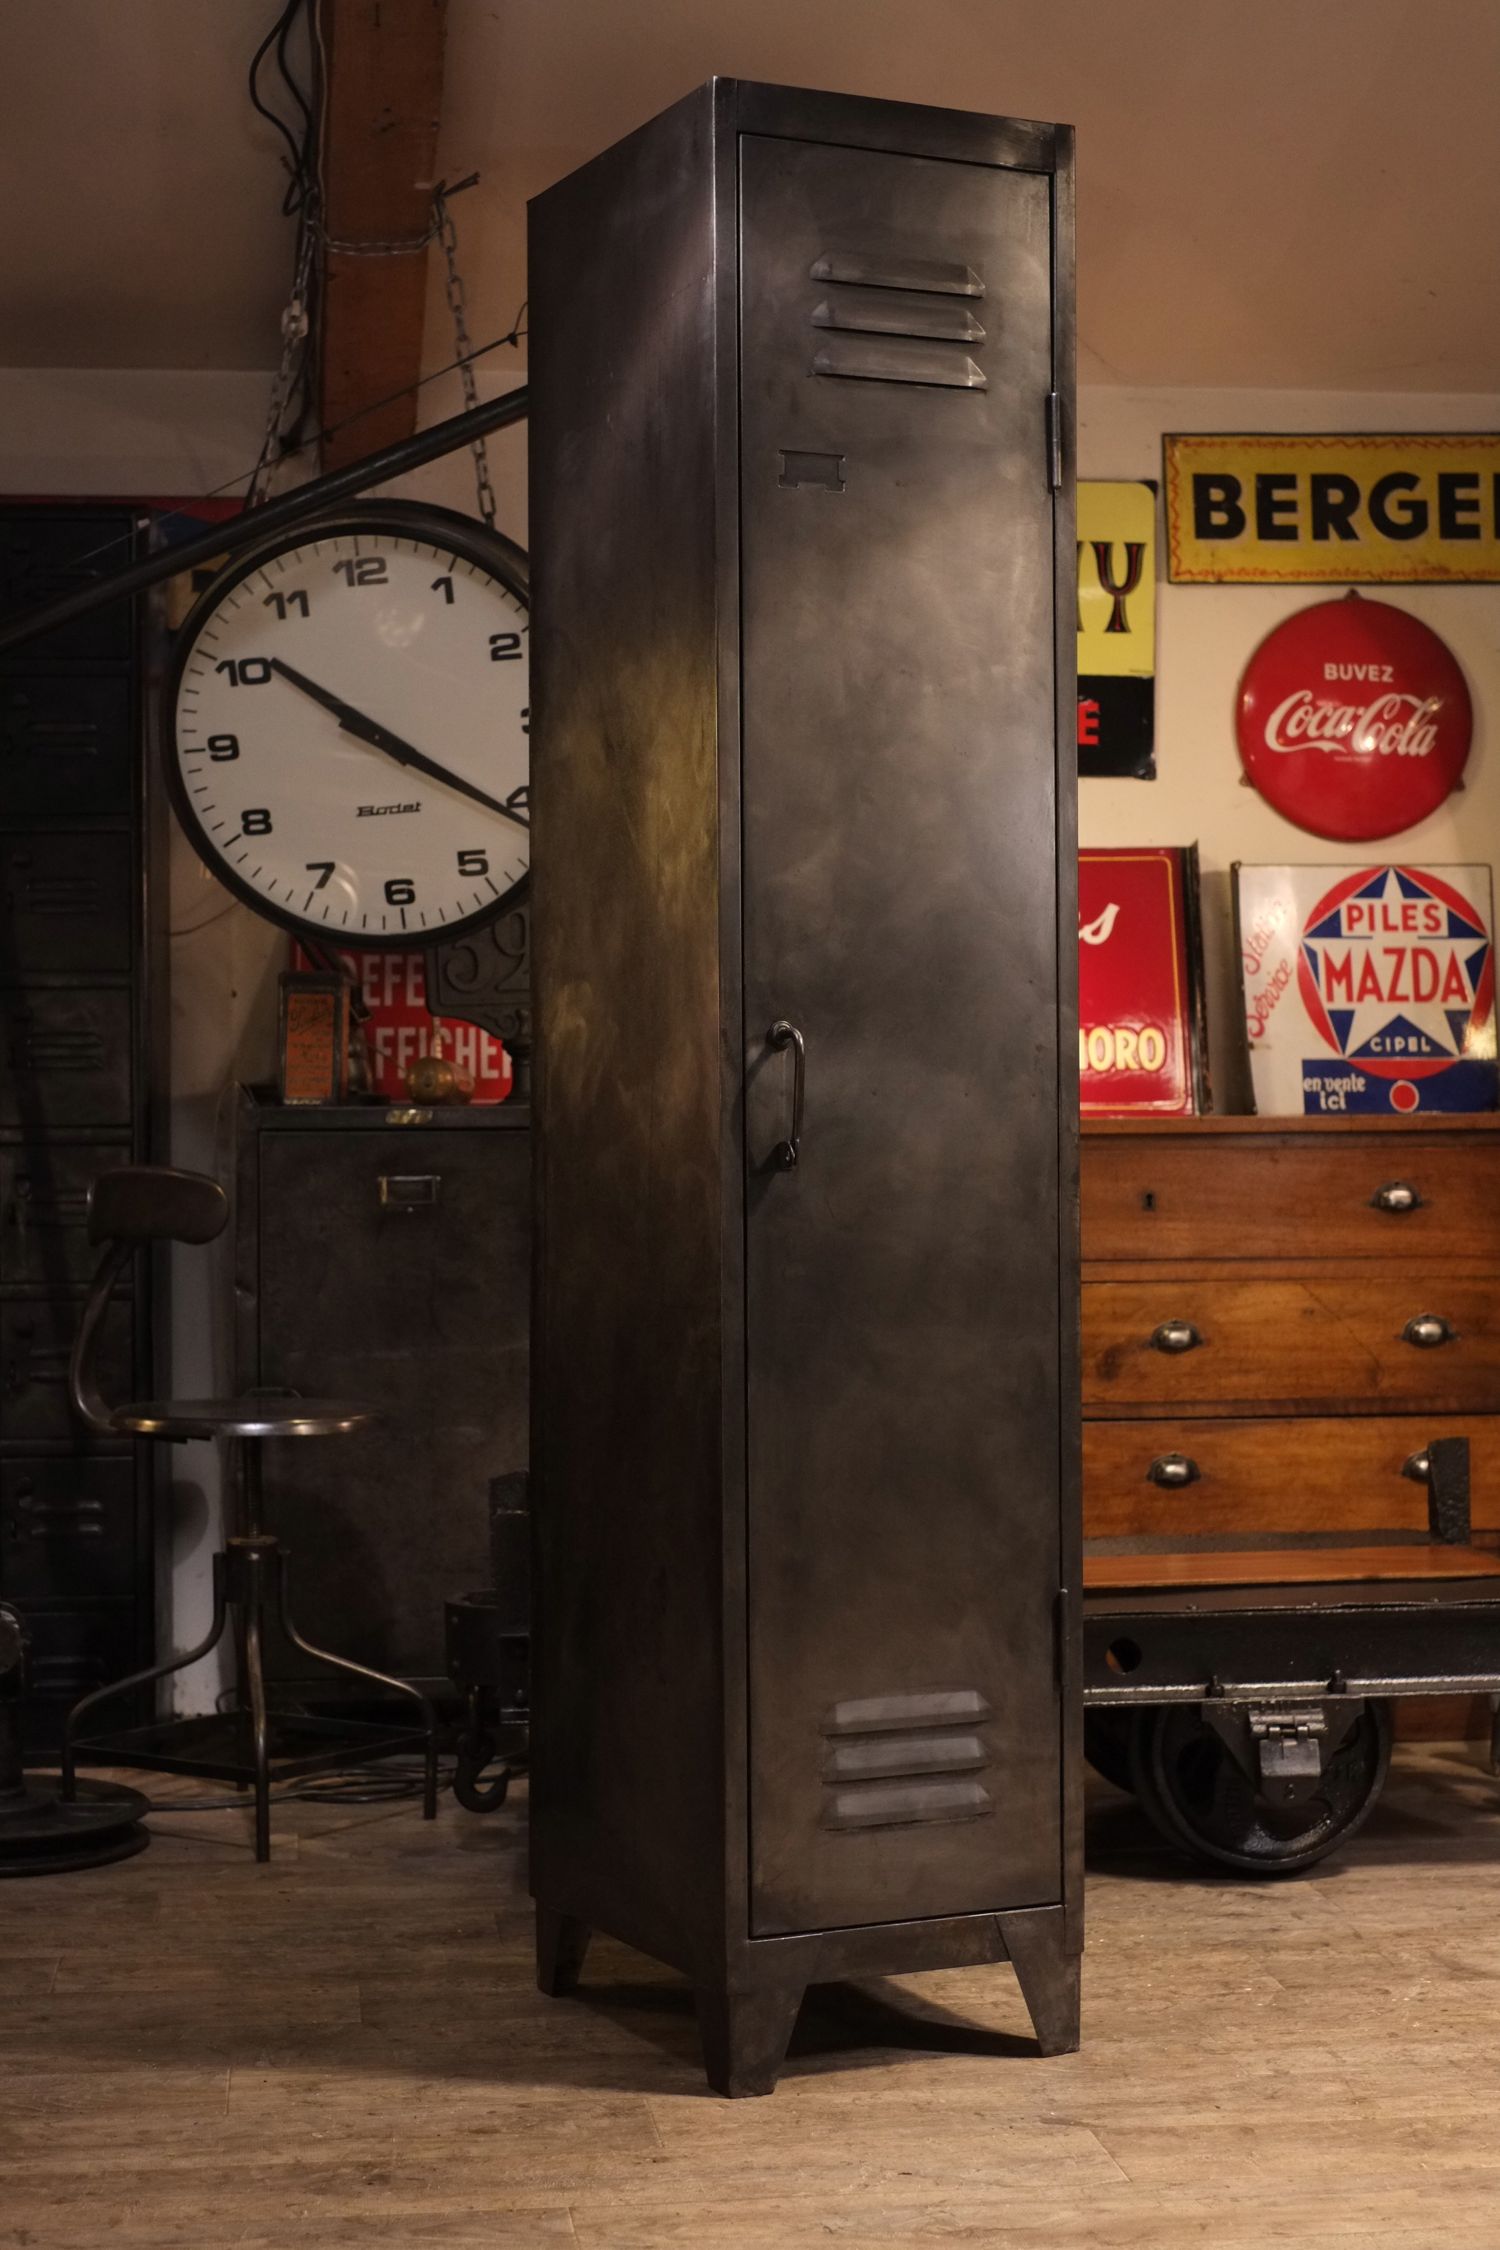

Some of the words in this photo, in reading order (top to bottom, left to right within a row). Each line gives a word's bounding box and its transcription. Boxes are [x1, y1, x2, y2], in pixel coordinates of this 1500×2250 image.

[1192, 471, 1500, 541] BERGE
[332, 556, 389, 587] 12
[431, 576, 455, 604] 1
[1077, 540, 1146, 633] Y
[263, 590, 310, 620] 11
[489, 633, 523, 661] 2
[215, 657, 272, 687] 10
[1324, 663, 1394, 683] BUVEZ
[207, 734, 240, 761] 9
[241, 809, 273, 836] 8
[357, 802, 421, 818] Bodet
[306, 862, 336, 889] 7
[457, 849, 489, 877] 5
[384, 878, 416, 906] 6
[1346, 903, 1442, 934] PILES
[340, 953, 424, 1007] EFE
[1323, 946, 1470, 1004] MAZDA
[350, 1026, 513, 1080] FFICHE
[1369, 1035, 1432, 1053] CIPEL
[1303, 1076, 1322, 1093] en
[1324, 1073, 1367, 1094] vente
[1320, 1091, 1347, 1110] ici
